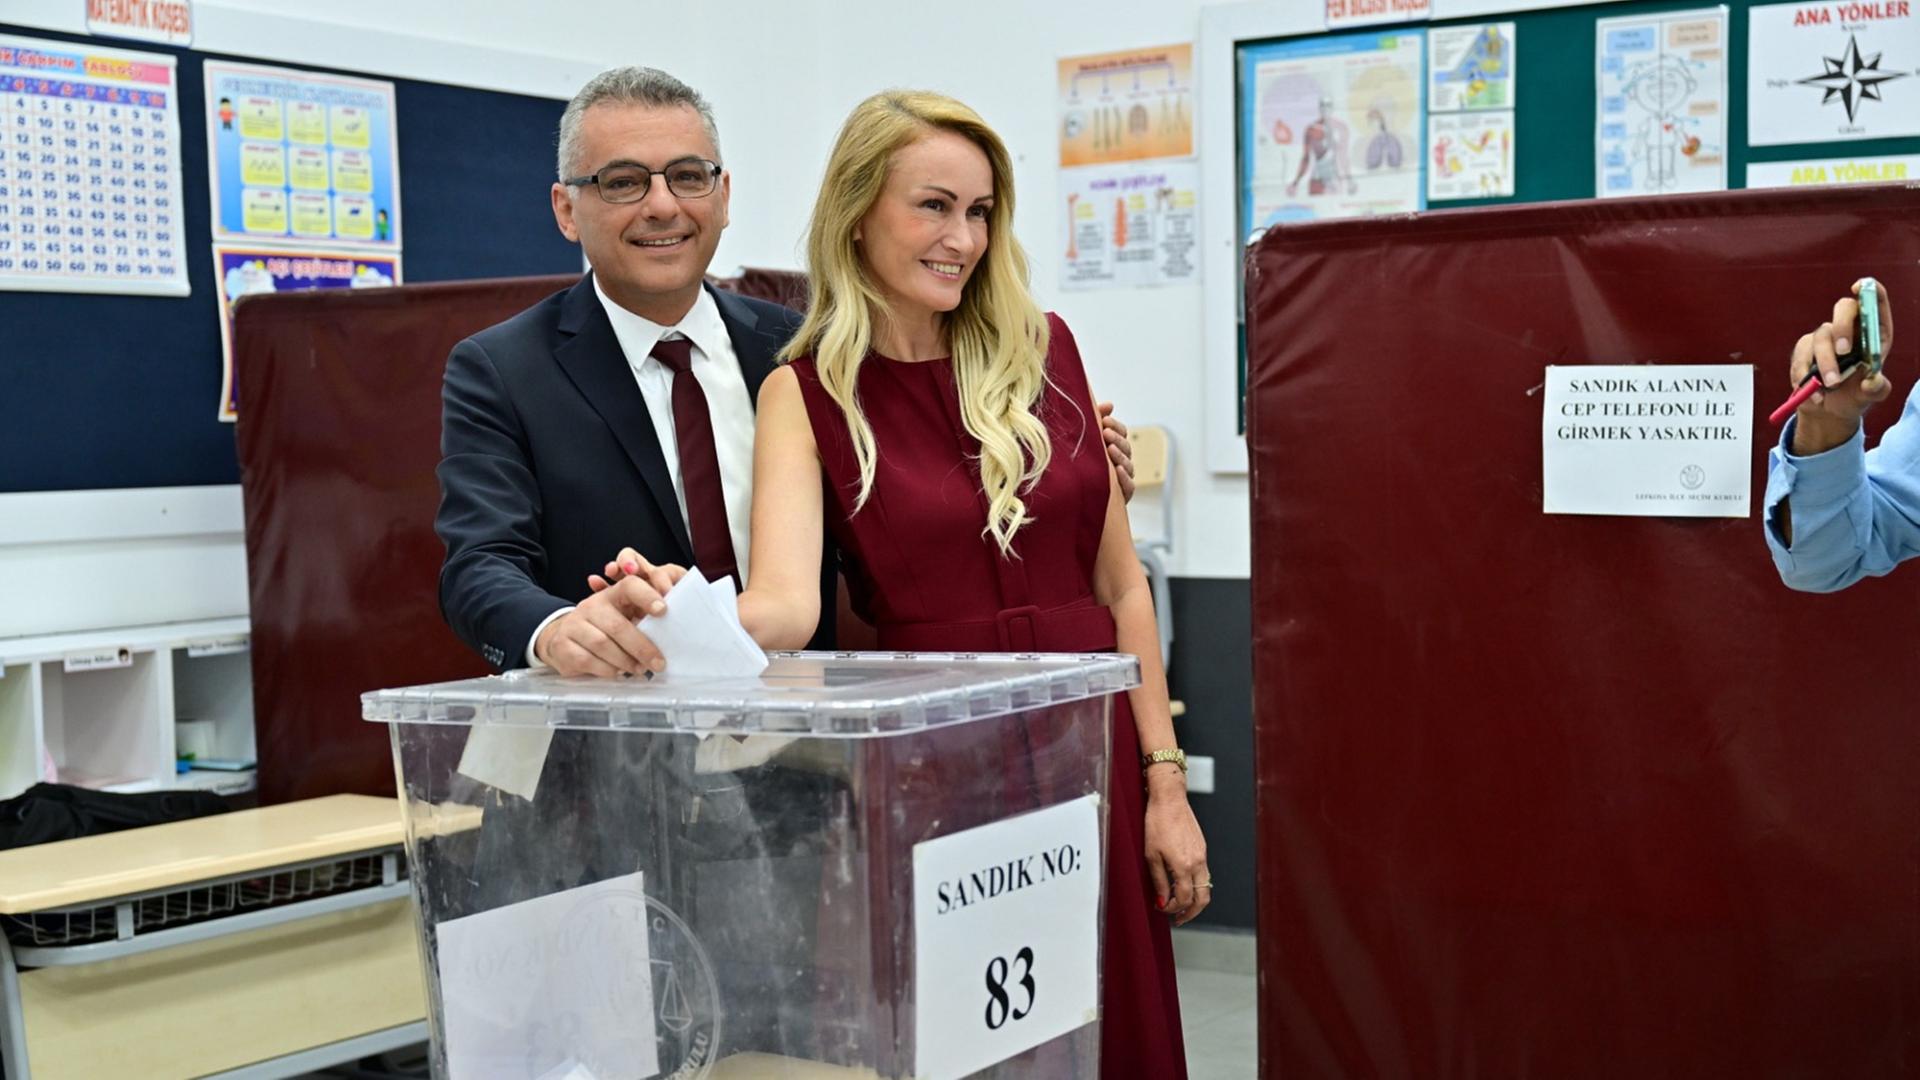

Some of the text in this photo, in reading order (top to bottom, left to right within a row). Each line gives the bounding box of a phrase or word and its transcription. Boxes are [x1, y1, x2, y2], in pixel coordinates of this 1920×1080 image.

[1794, 1, 1909, 26] ANA YÖNLER
[1791, 160, 1908, 185] ARA YÖNLER
[1570, 379, 1728, 393] SANDIK ALANINA
[1561, 400, 1735, 416] CEP TELEFONU İLE
[1557, 423, 1738, 441] GİRMEK YASAKTIR.
[937, 844, 1081, 915] SANDIK NO:
[984, 946, 1036, 1030] 83
